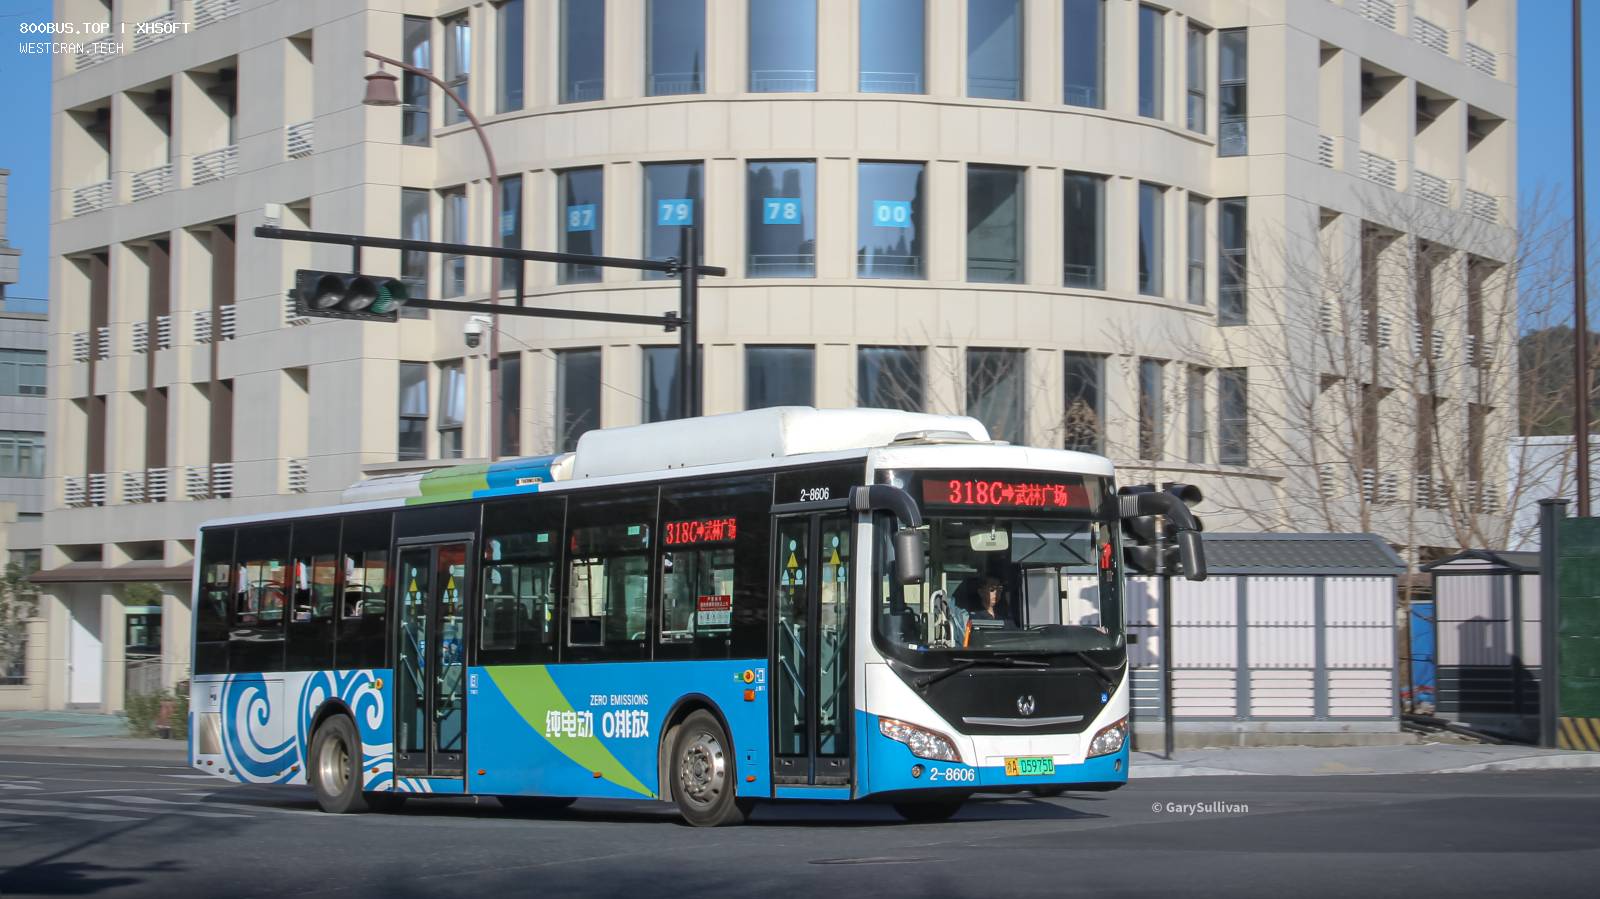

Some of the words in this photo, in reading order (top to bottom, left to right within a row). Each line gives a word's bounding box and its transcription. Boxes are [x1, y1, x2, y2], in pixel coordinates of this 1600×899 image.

[569, 208, 593, 227] 87
[662, 203, 689, 221] 79
[768, 202, 797, 220] 78
[800, 487, 830, 501] 2-8606
[949, 479, 1003, 505] 318C
[1014, 484, 1068, 507] 武林广场
[666, 521, 698, 544] 318C
[590, 694, 608, 706] ZERO
[610, 694, 649, 706] EMISSIONS
[545, 710, 593, 738] 纯电动
[929, 767, 975, 782] 2-8606
